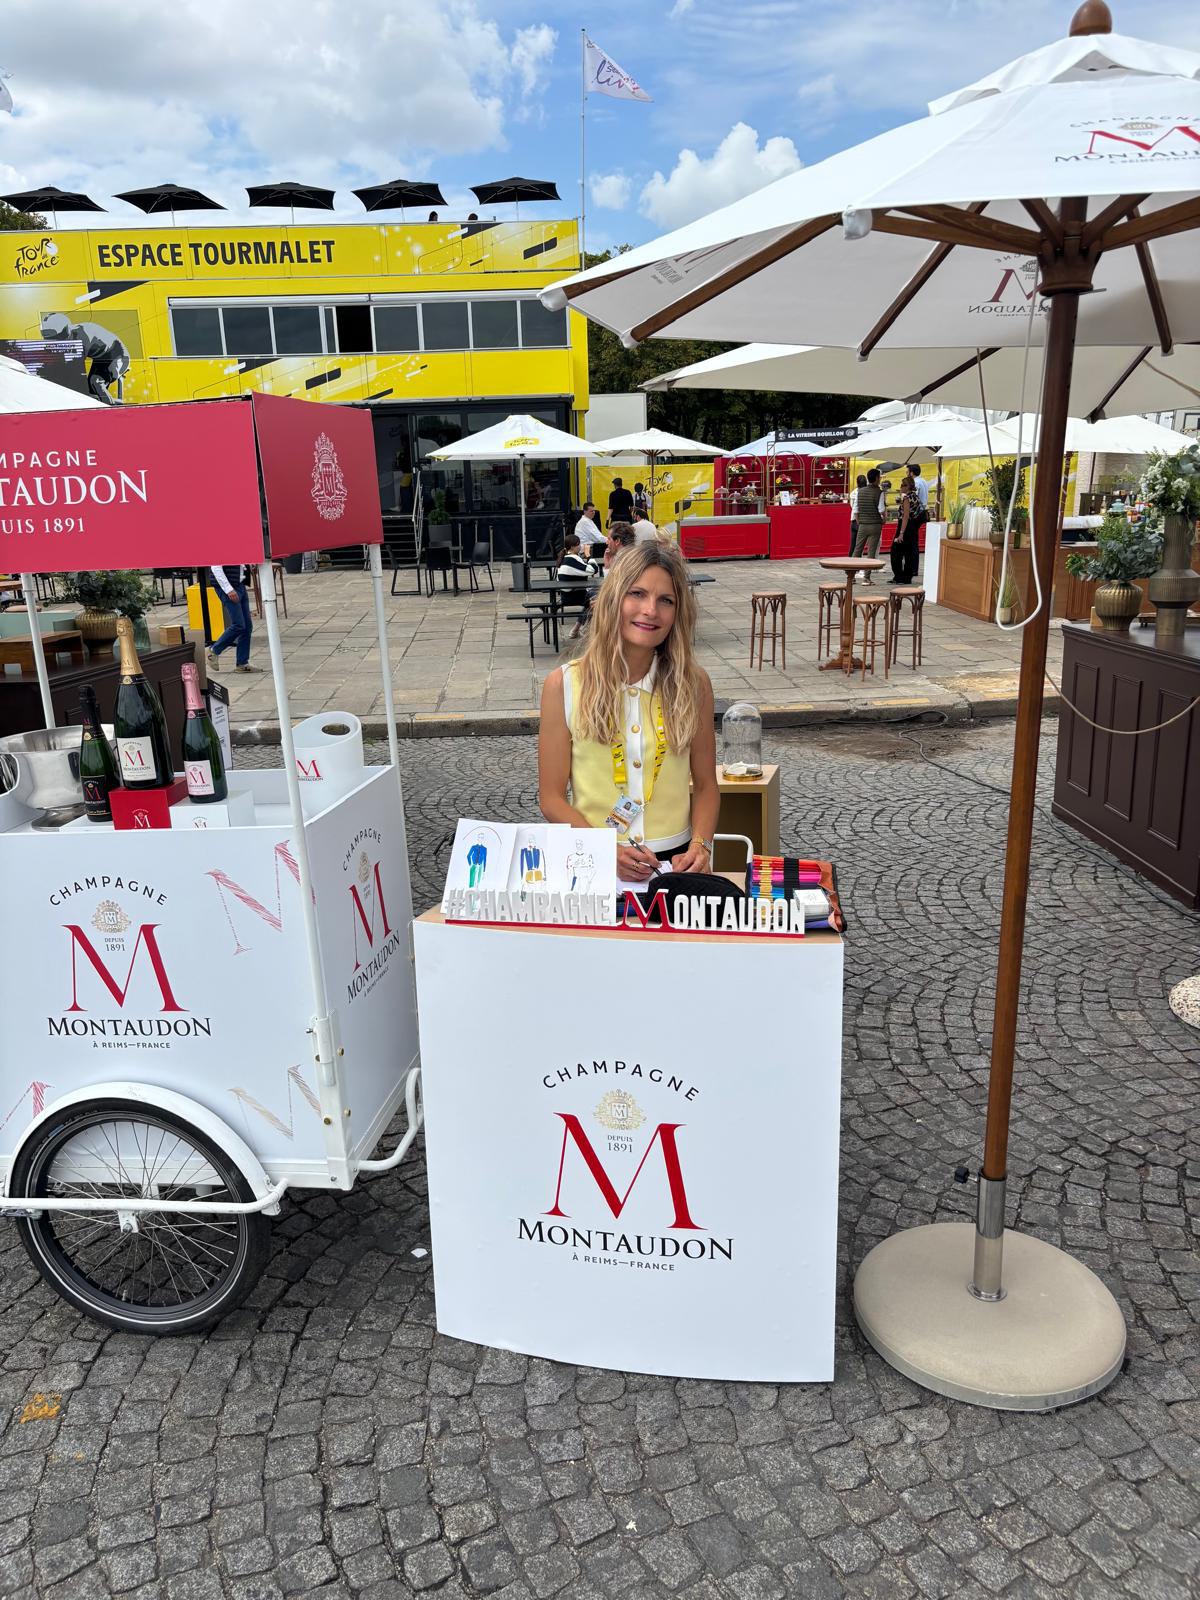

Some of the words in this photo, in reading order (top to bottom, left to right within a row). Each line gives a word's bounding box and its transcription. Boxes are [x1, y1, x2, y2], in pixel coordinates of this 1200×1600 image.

[97, 244, 184, 268] ESPACE
[188, 240, 336, 266] TOURMALET
[1, 518, 35, 535] UIS
[43, 516, 85, 533] 1891
[125, 750, 145, 767] M
[294, 759, 322, 778] M
[133, 814, 152, 829] M
[343, 827, 382, 872] CHAMPAGNE
[49, 875, 168, 907] CHAMPAGNE
[349, 860, 393, 975] M
[445, 887, 613, 926] #CHAMPAGNE
[616, 887, 806, 934] MONTAUDON
[105, 943, 126, 952] 1891
[60, 923, 192, 1013] M
[346, 929, 401, 1004] MONTAUDON
[47, 1016, 213, 1037] MONTAUDON
[93, 1040, 99, 1049] À
[543, 1060, 700, 1102] CHAMPAGNE
[607, 1134, 633, 1143] DEPUIS
[608, 1143, 633, 1153] 1891
[538, 1112, 709, 1231] M
[516, 1217, 735, 1261] MONTAUDON
[572, 1252, 580, 1262] À
